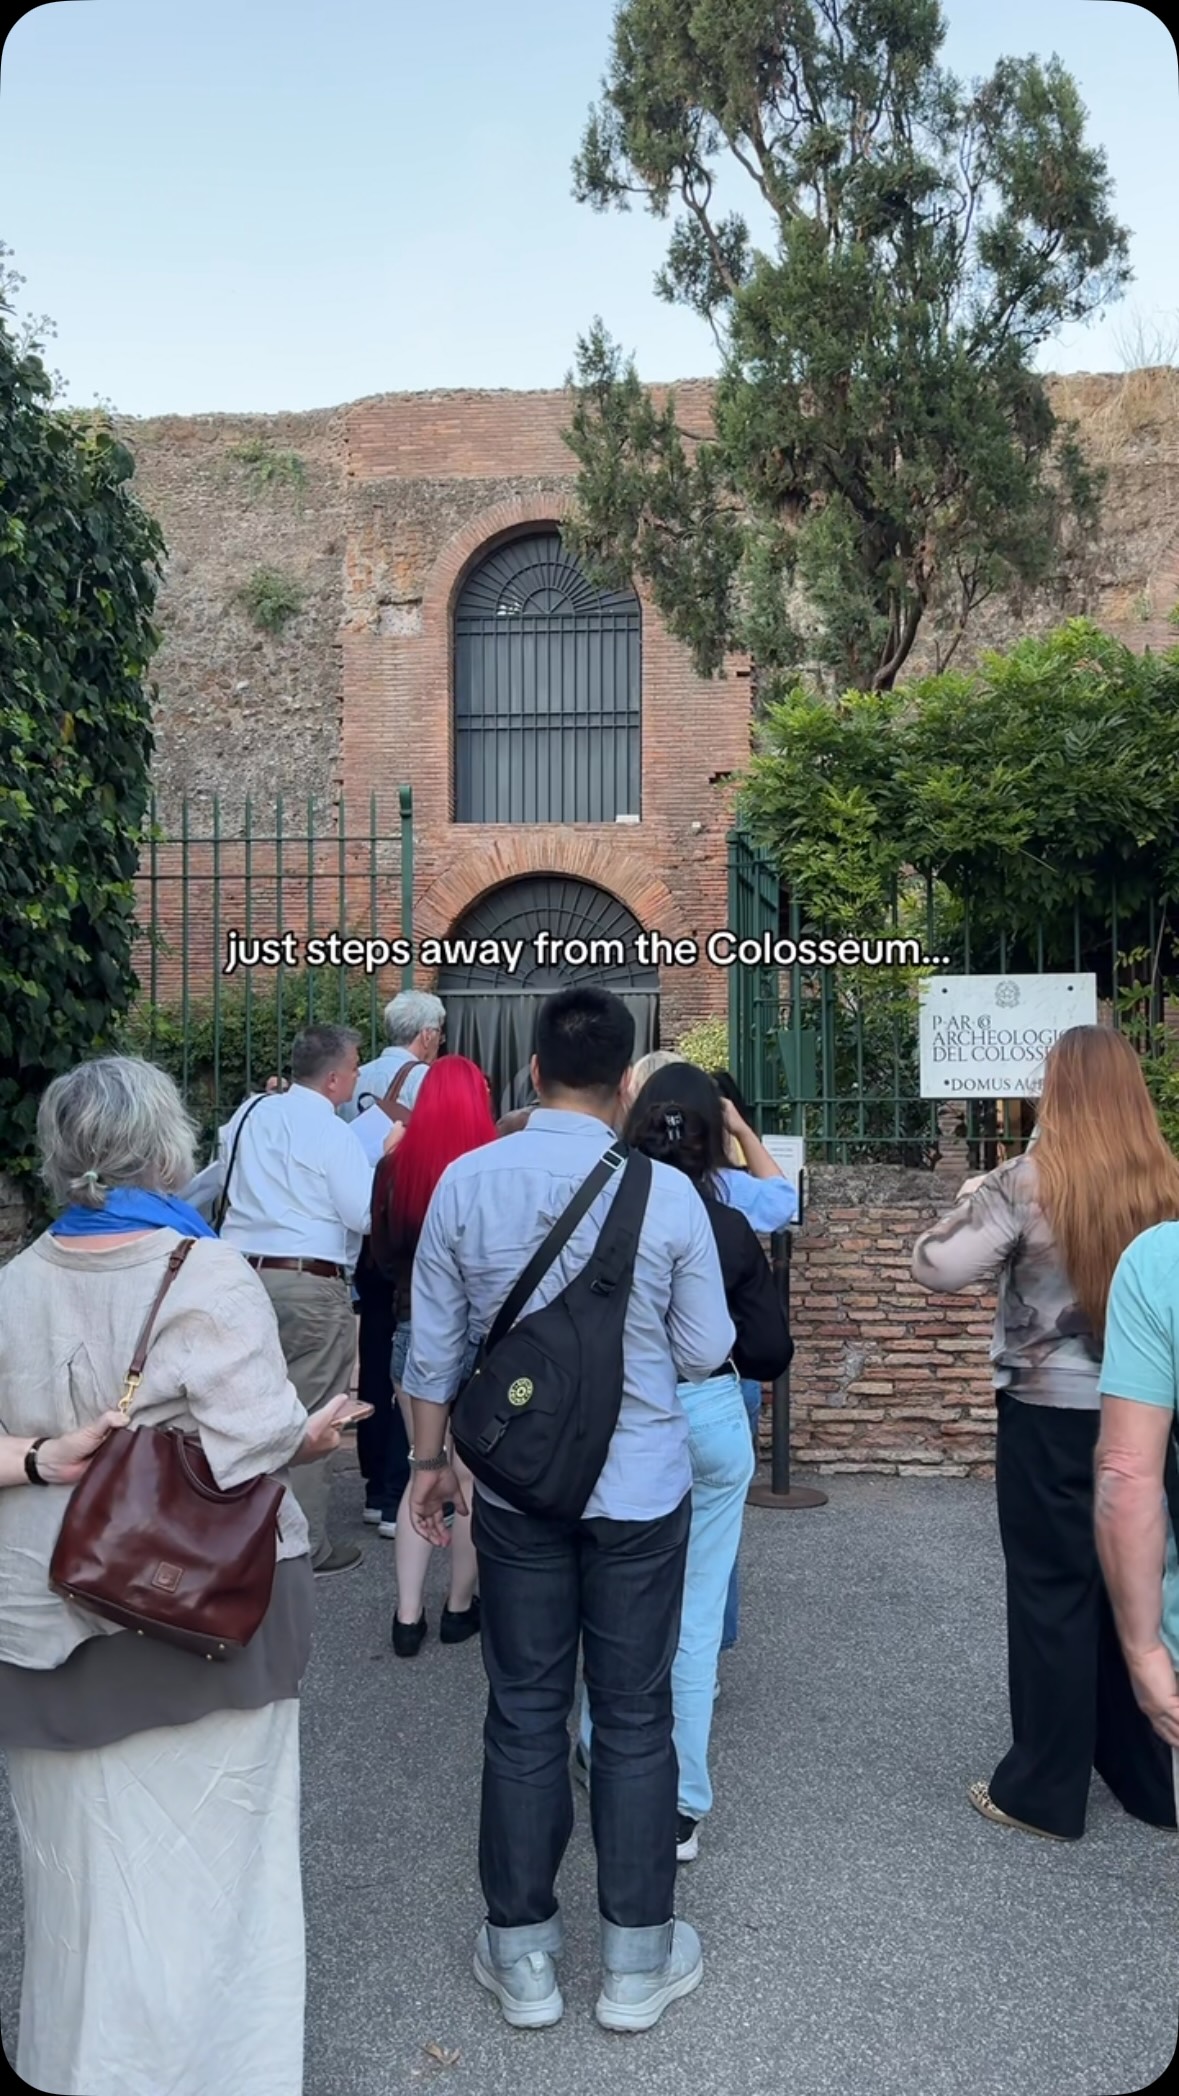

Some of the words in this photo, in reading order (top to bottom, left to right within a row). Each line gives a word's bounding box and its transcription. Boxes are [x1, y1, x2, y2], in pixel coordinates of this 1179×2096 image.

[932, 1029, 1065, 1046] ARCHEOLOGI
[932, 1046, 967, 1062] DEL
[971, 1045, 1049, 1062] COLOSS
[951, 1078, 1011, 1092] DOMUS
